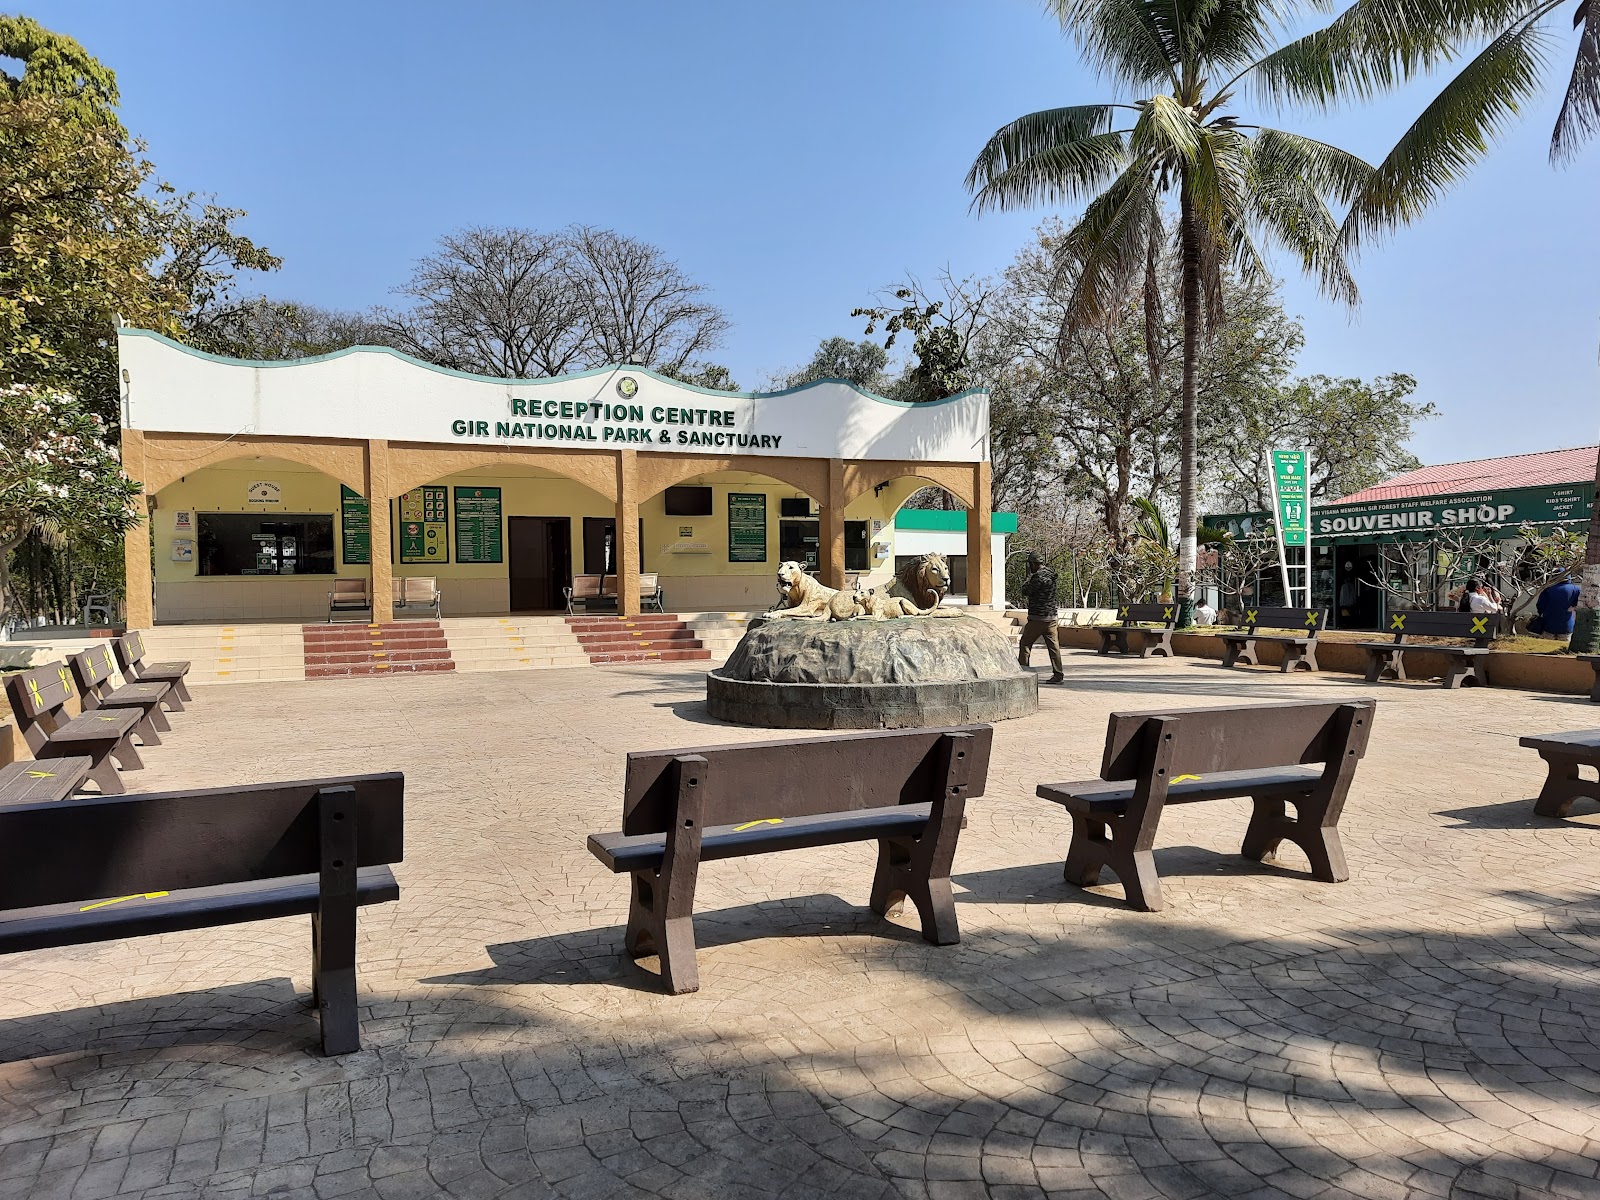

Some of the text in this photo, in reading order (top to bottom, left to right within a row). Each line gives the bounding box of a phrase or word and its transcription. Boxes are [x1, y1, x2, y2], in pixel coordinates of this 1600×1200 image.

[511, 398, 736, 427] RECEPTION CENTRE
[452, 419, 783, 449] GIR NATIONAL PARK & SANCTUARY
[1320, 510, 1434, 533] SOUVENIR
[1441, 504, 1515, 525] SHOP
[1340, 506, 1367, 514] MEMORIAL
[1420, 499, 1448, 507] WELFARE
[1449, 495, 1493, 504] ASSOCIATION
